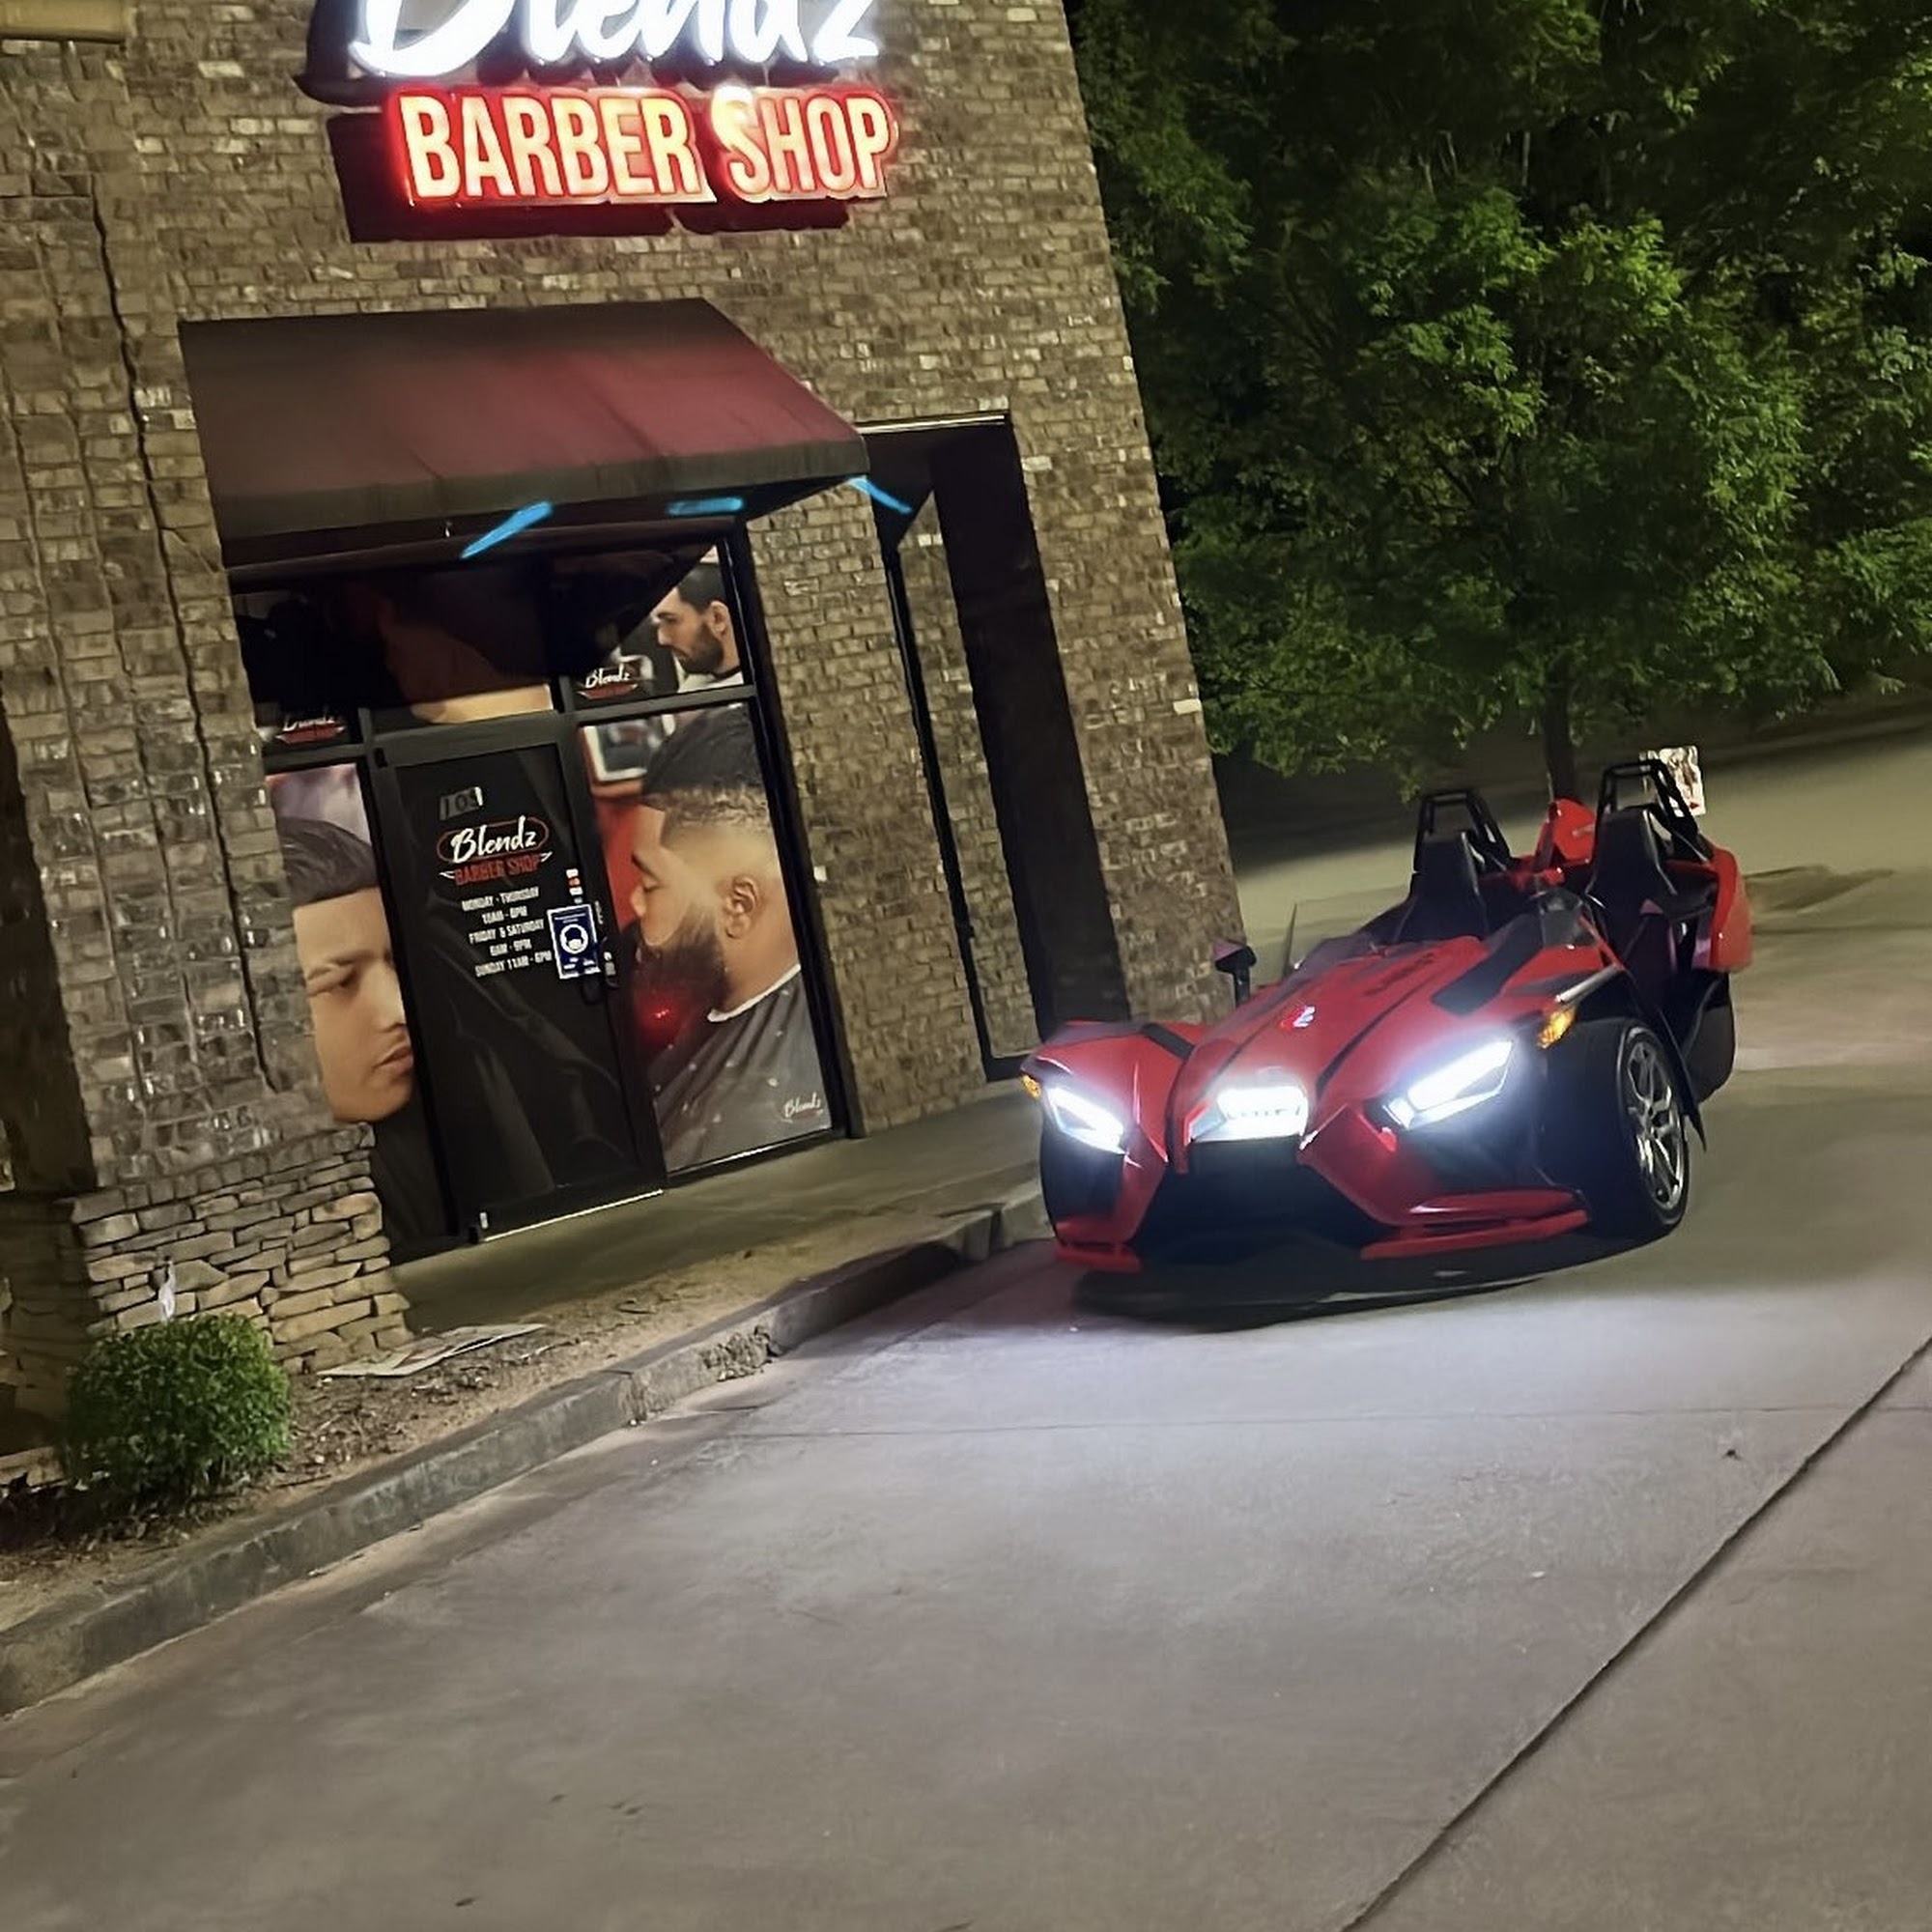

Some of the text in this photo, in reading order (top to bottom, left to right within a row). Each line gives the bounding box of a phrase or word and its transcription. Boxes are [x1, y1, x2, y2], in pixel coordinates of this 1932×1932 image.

[398, 86, 895, 201] BARBER SHOP
[450, 814, 537, 864] Blendz
[506, 919, 544, 937] SATURDAY
